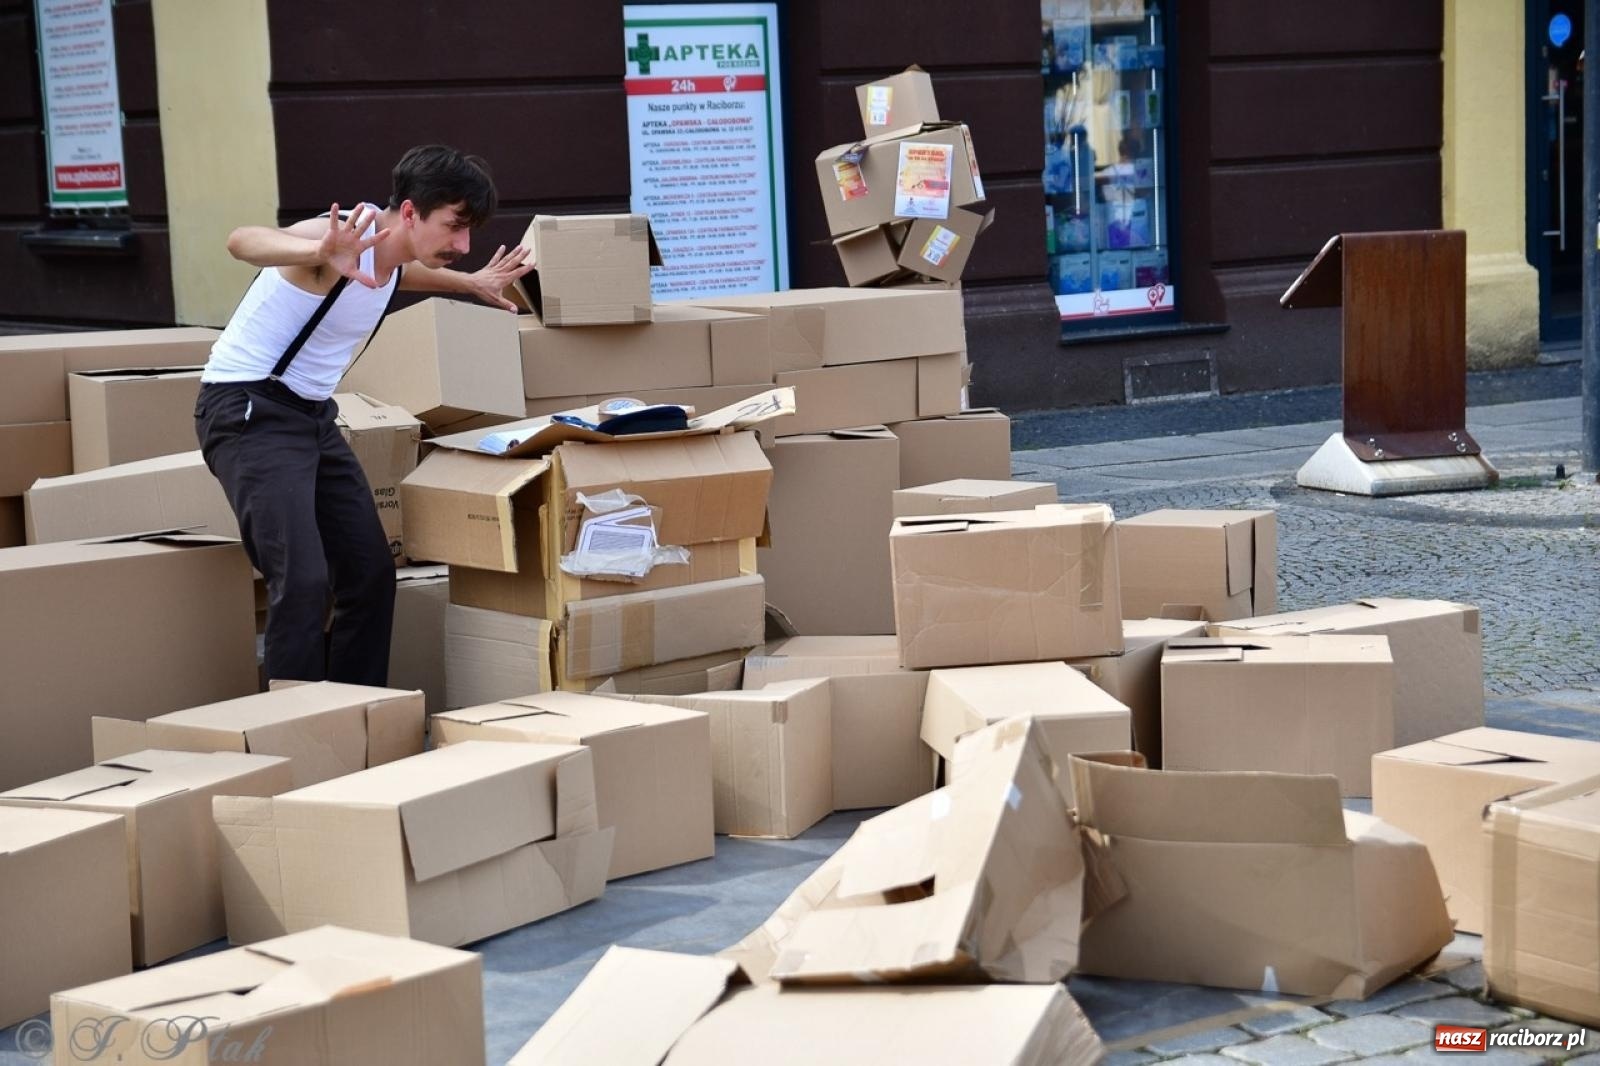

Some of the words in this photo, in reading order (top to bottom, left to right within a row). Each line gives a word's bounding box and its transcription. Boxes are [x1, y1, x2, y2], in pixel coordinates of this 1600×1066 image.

[663, 43, 760, 61] APTEKA
[671, 79, 696, 92] 24h
[648, 103, 670, 112] Nasze
[672, 102, 697, 113] punkty
[374, 486, 396, 497] Glas
